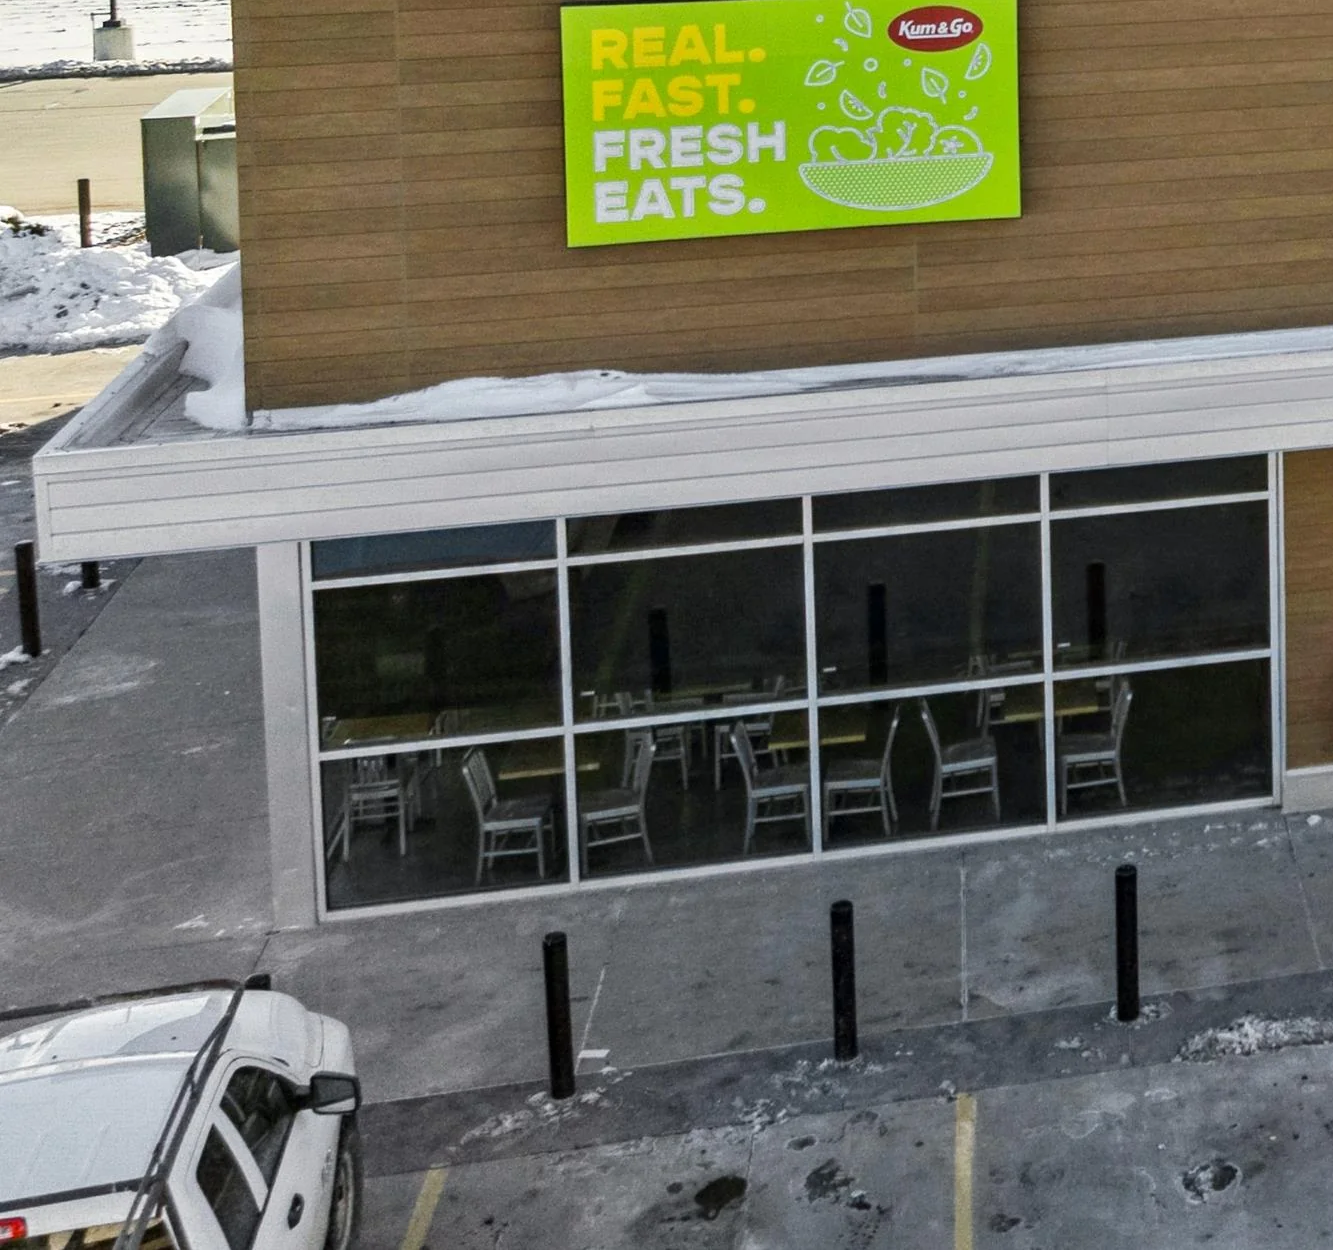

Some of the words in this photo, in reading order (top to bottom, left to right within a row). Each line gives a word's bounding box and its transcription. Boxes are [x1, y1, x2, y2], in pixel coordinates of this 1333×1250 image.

[591, 23, 766, 71] REAL.
[898, 19, 937, 40] Kum
[949, 17, 973, 38] Go
[592, 73, 756, 122] FAST.
[594, 120, 787, 173] FRESH
[594, 173, 766, 224] EATS.
